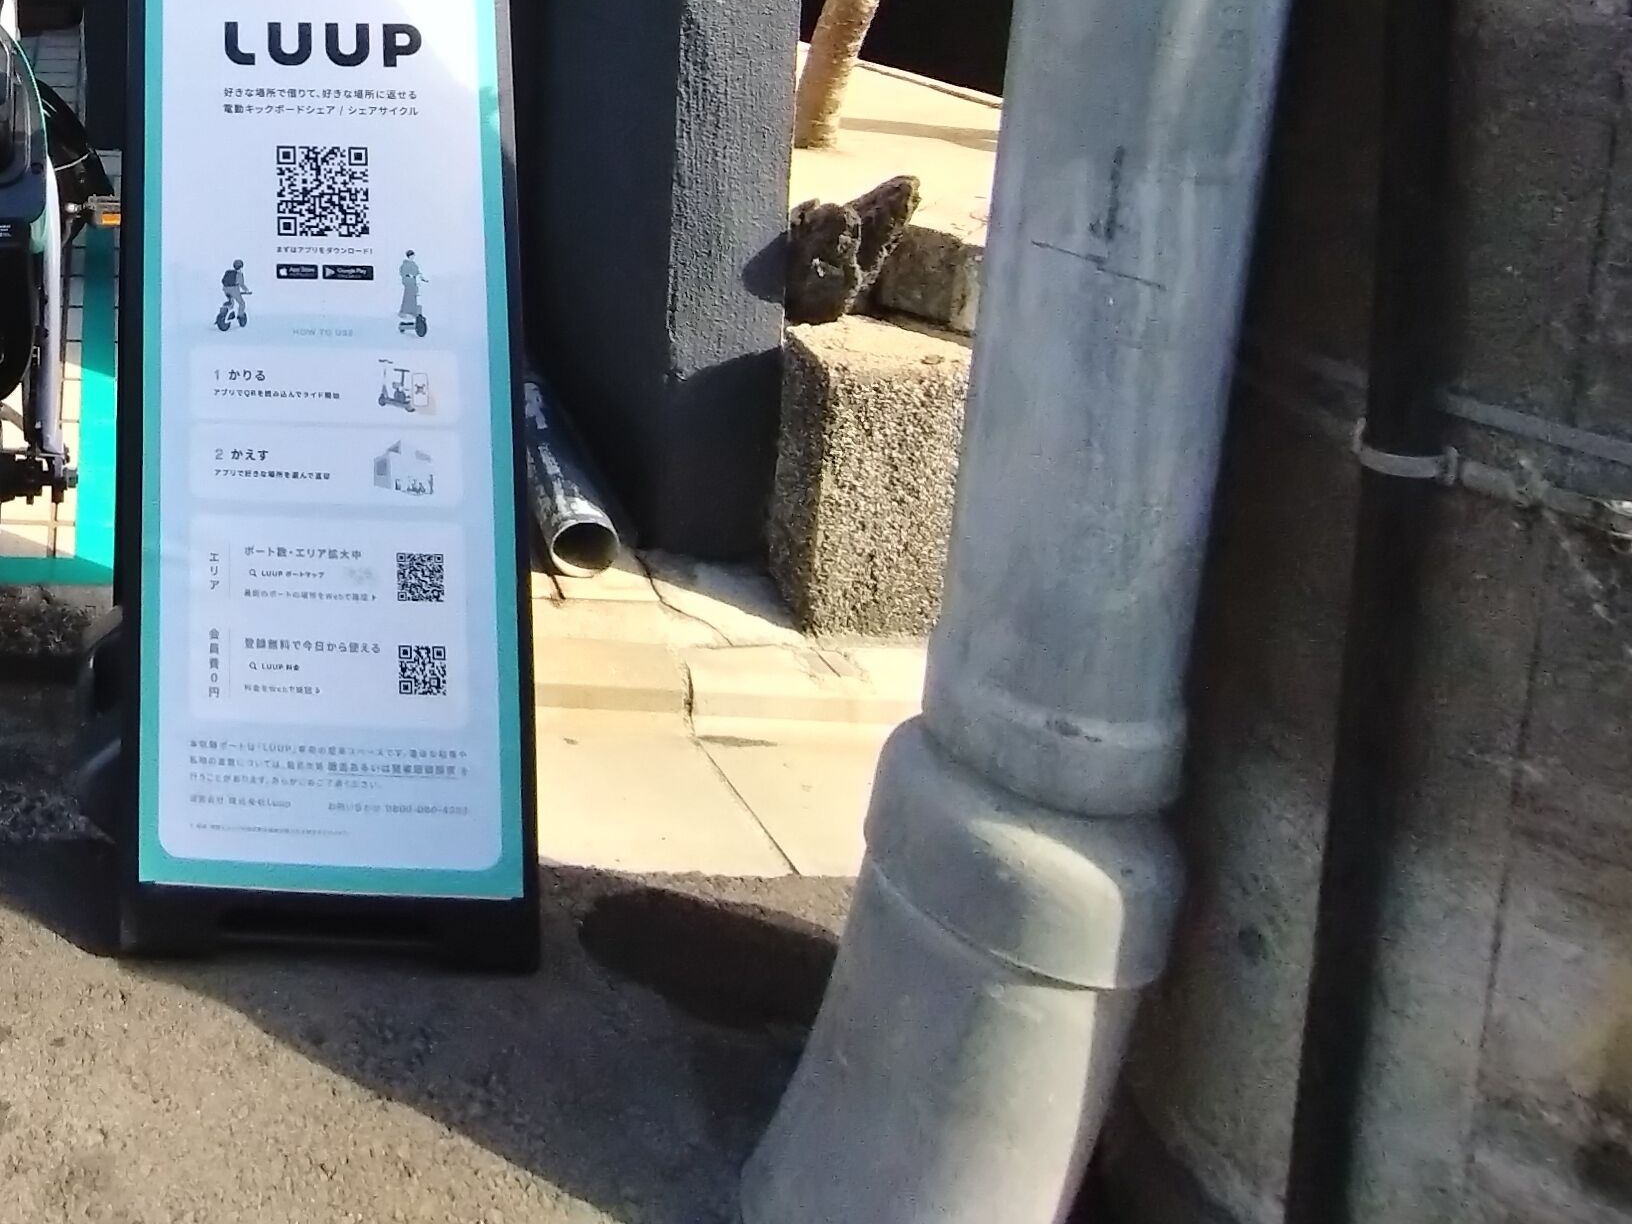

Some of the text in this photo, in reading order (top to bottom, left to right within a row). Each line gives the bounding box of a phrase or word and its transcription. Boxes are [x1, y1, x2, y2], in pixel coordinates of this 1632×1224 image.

[224, 21, 422, 68] LUUP
[223, 87, 418, 101] 好きな場所で借りて、好きな場所に返せる
[223, 103, 336, 116] 電動キックボードシェア
[348, 105, 419, 117] シェアサイクル
[228, 369, 266, 381] かりる
[215, 448, 269, 461] 2 かえす
[209, 552, 220, 591] エリア
